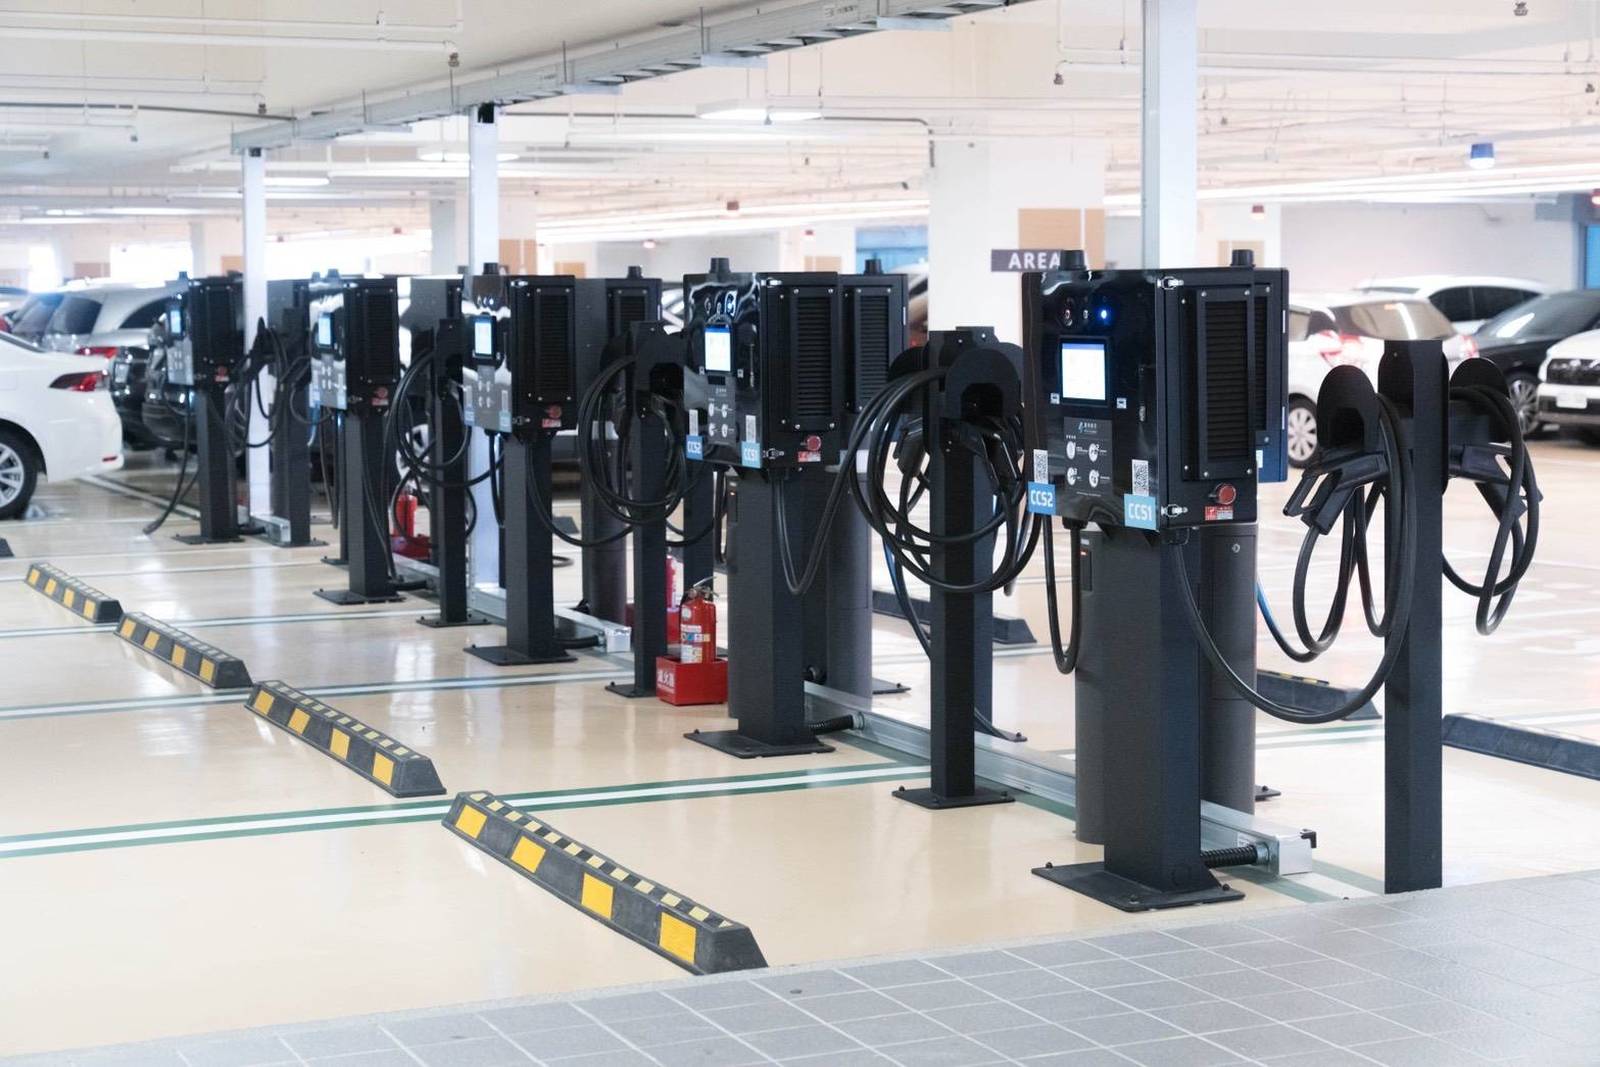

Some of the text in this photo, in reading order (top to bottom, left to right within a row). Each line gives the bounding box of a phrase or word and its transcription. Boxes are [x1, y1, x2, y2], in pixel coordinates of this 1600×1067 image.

[1008, 252, 1061, 269] AREA
[1030, 489, 1054, 507] CCS2
[1128, 503, 1153, 520] CCS1
